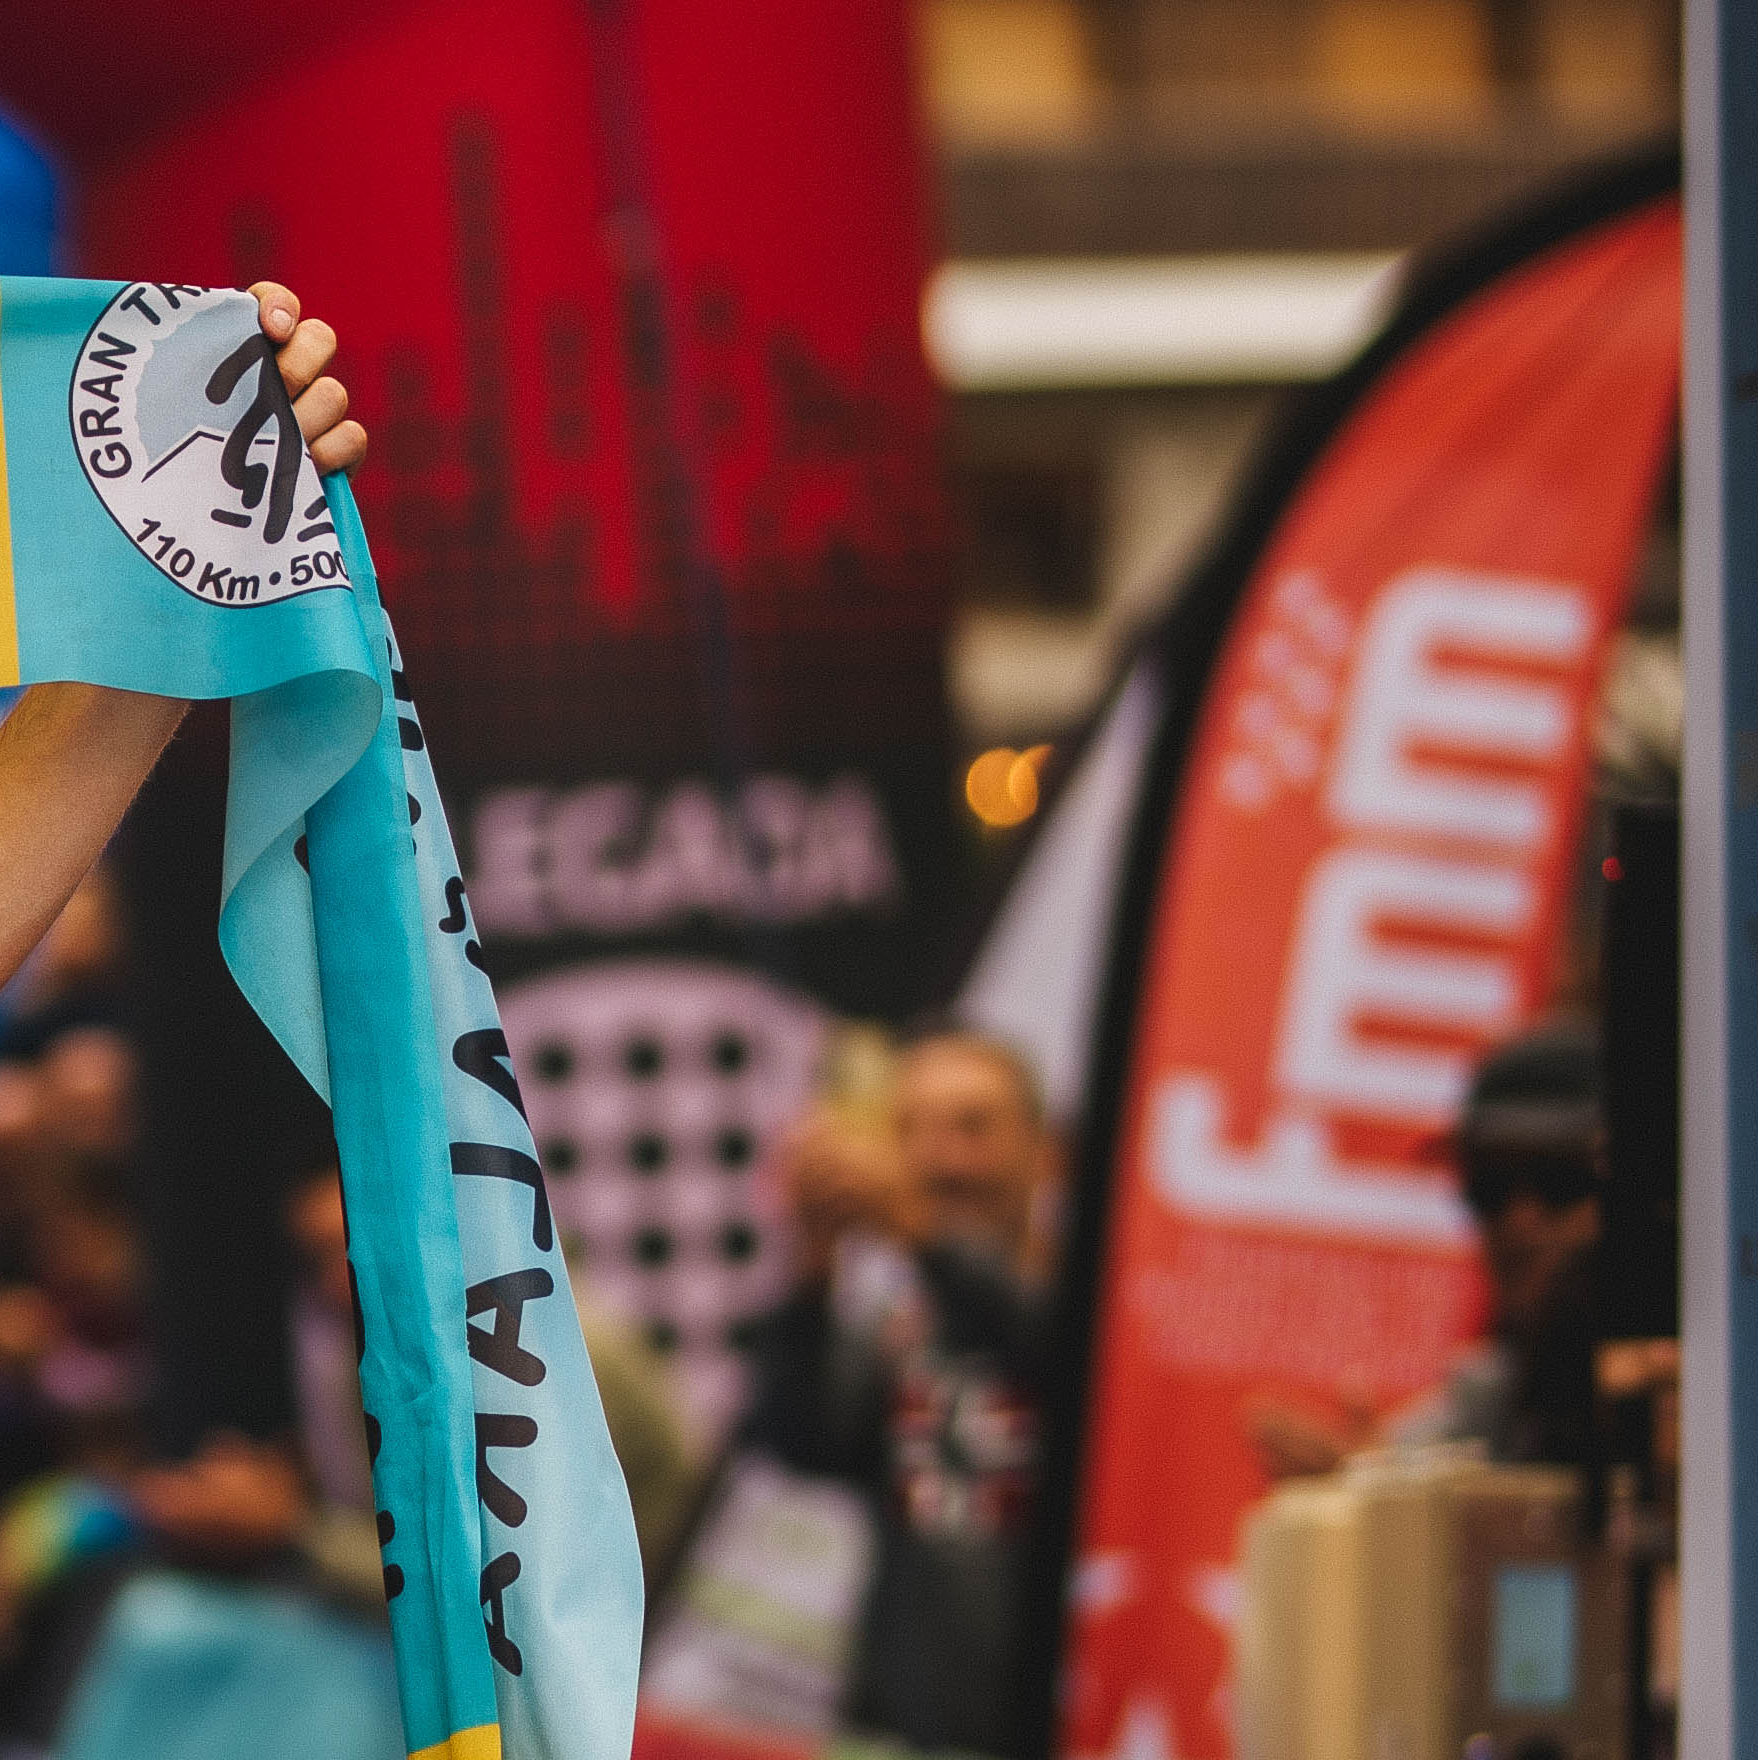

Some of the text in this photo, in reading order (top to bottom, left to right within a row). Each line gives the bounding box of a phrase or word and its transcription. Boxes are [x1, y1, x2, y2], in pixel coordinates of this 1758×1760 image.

[79, 332, 137, 479] GRAN
[136, 517, 196, 579] 110
[196, 561, 260, 601] Km
